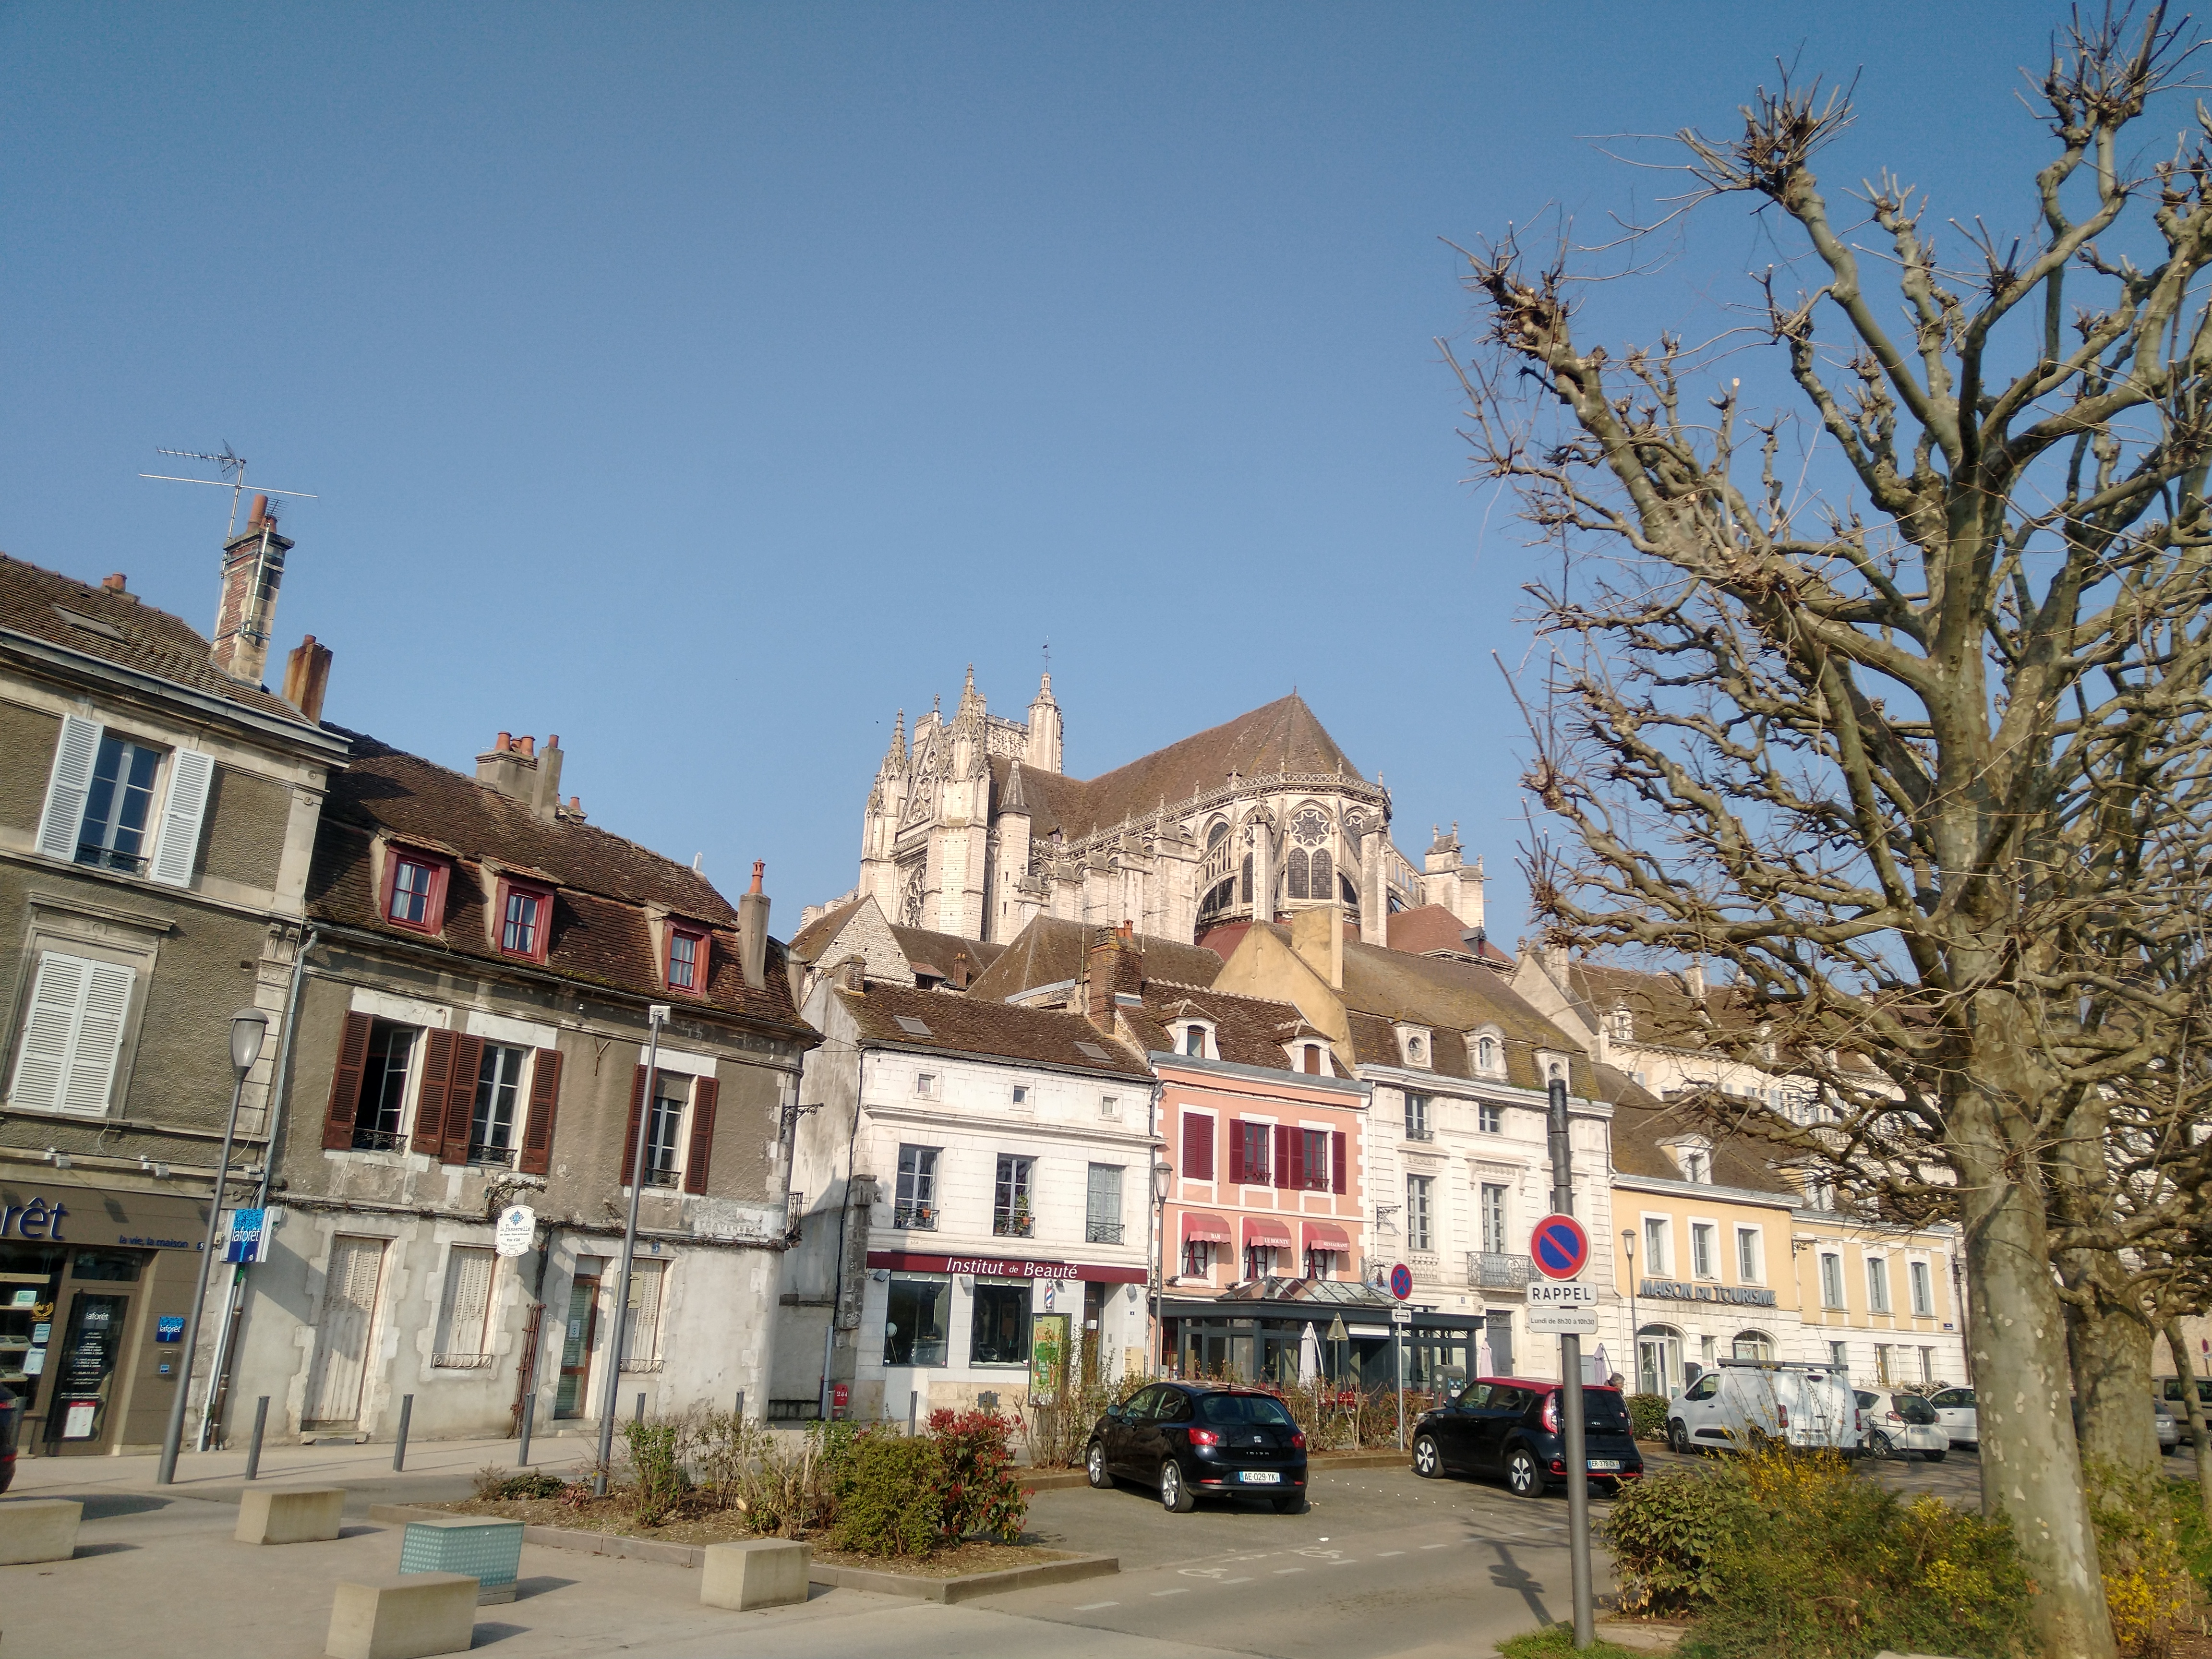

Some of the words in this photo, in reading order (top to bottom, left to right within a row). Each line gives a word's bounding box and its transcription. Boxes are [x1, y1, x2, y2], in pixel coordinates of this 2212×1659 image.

[232, 1226, 260, 1241] laforêt
[120, 1235, 127, 1244] la
[147, 1237, 154, 1245] la
[156, 1239, 188, 1248] maison
[946, 1257, 1004, 1275] Institut
[1009, 1265, 1018, 1273] de
[1024, 1262, 1077, 1279] Beauté
[1532, 1287, 1591, 1300] RAPPEL
[1640, 1279, 1693, 1299] MAISON
[1695, 1286, 1712, 1299] DU
[1713, 1286, 1776, 1305] TOURISME
[86, 1312, 109, 1320] laforêt
[1245, 1473, 1275, 1481] AE-029-YK
